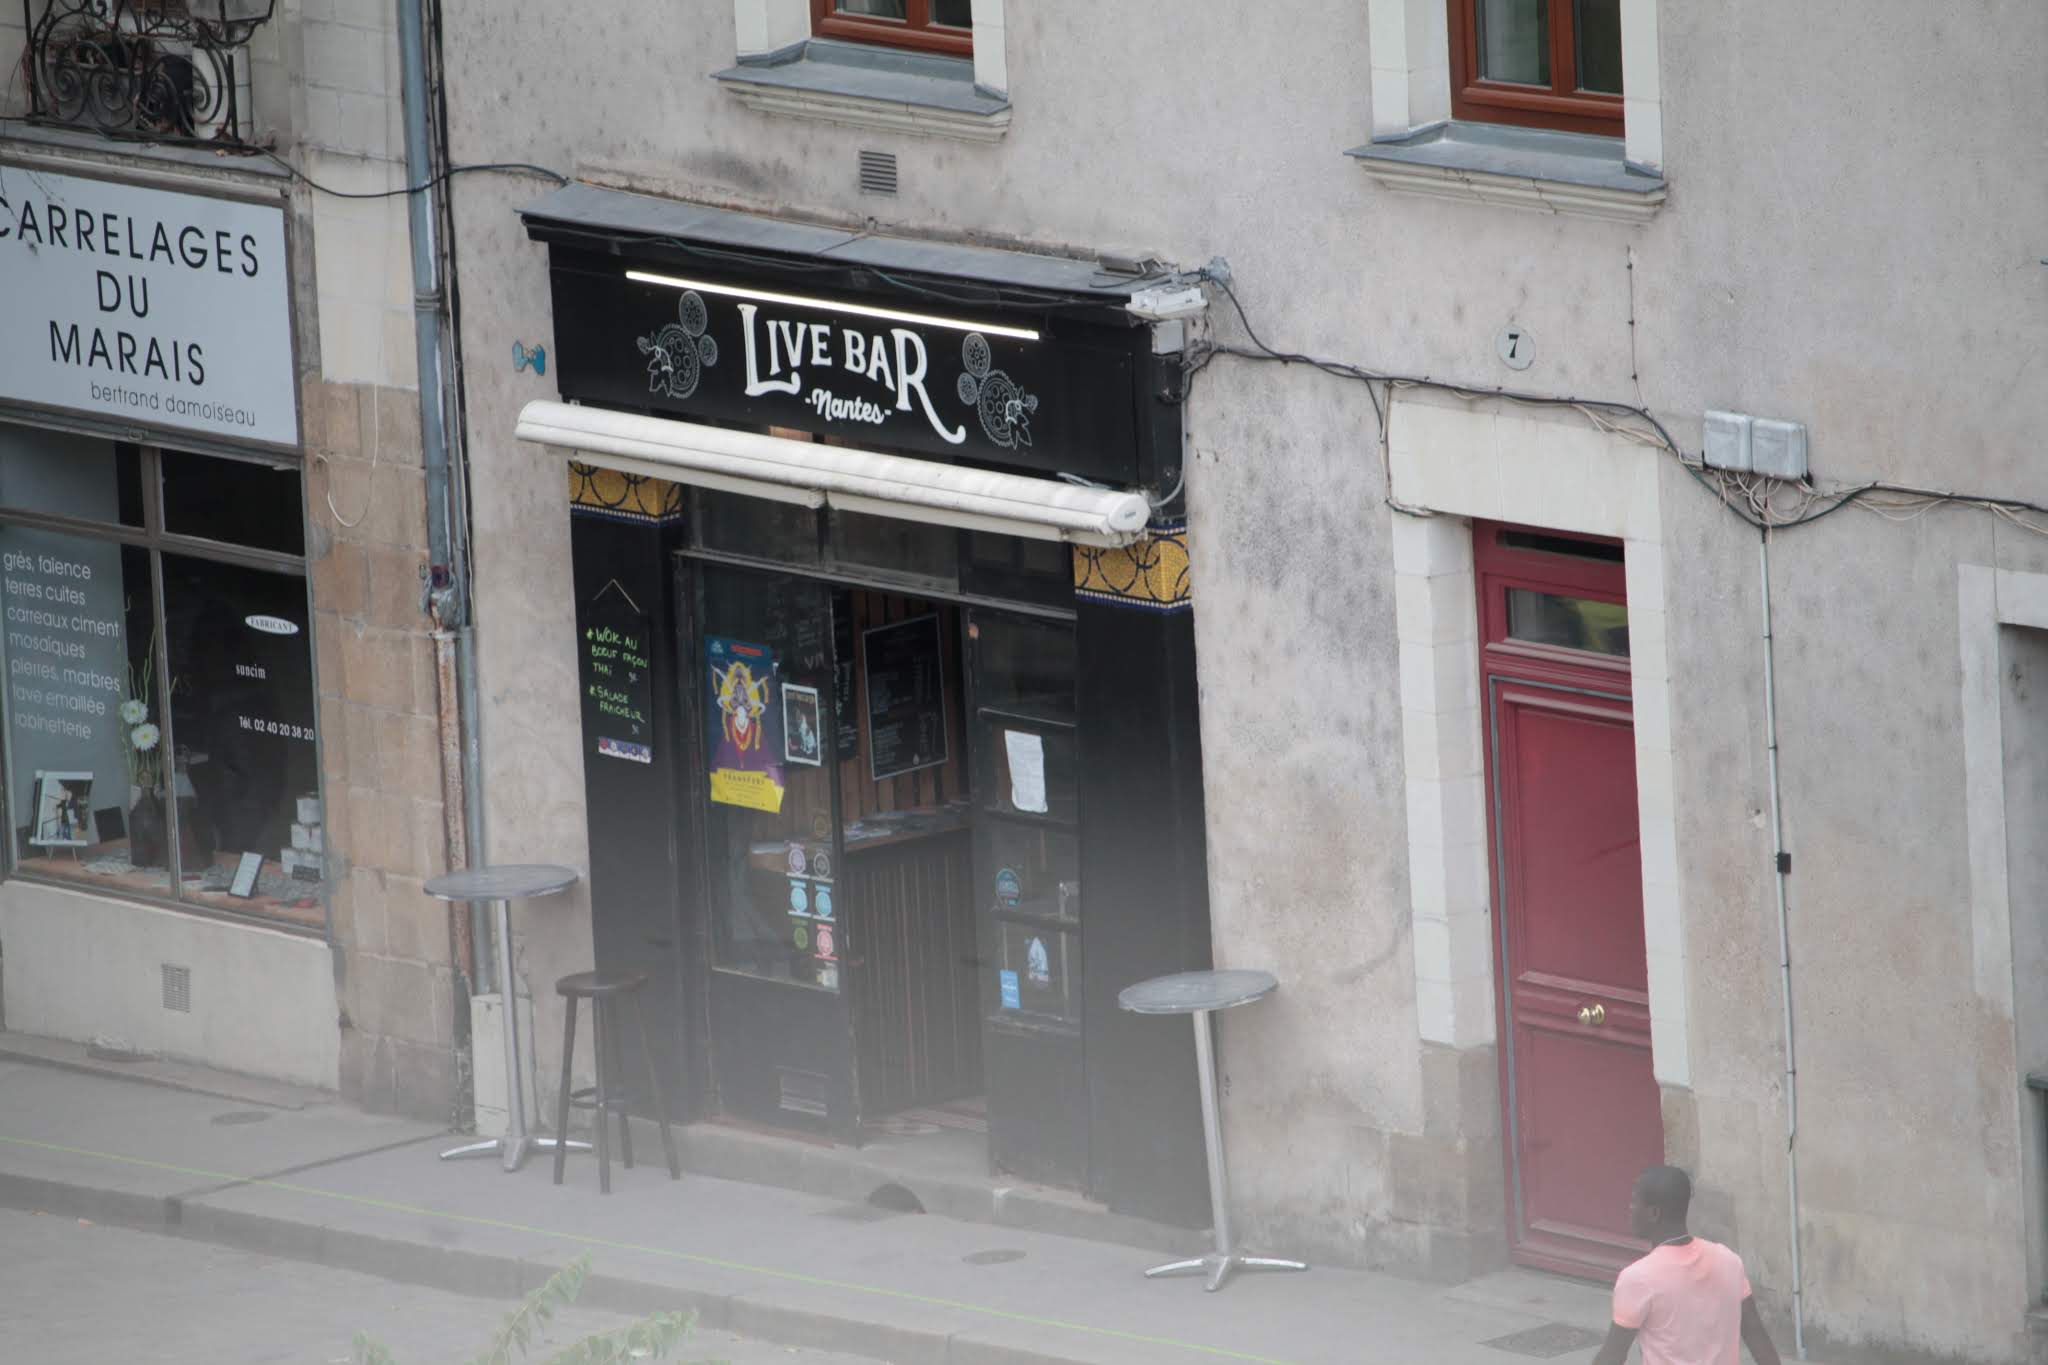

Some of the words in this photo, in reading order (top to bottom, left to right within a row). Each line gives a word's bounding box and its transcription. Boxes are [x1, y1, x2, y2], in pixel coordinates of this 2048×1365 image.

[96, 270, 149, 318] DU
[49, 320, 206, 386] MARAIS
[1508, 334, 1520, 359] 7
[843, 328, 967, 445] BAR
[90, 381, 159, 410] bertrand
[165, 394, 256, 427] damoiseau
[3, 551, 34, 572] grès,
[38, 554, 91, 580] faïence
[5, 577, 42, 598] terres
[45, 584, 86, 606] cuites
[7, 607, 68, 630] carreaux
[71, 615, 120, 638] ciment
[9, 631, 86, 659] mosaïques
[624, 636, 638, 650] AU
[13, 681, 42, 703] lave
[63, 668, 121, 692] marbres
[15, 711, 92, 740] robinetterie
[254, 718, 265, 732] 02
[266, 721, 278, 735] 40
[279, 723, 290, 737] 20
[303, 727, 315, 741] 20
